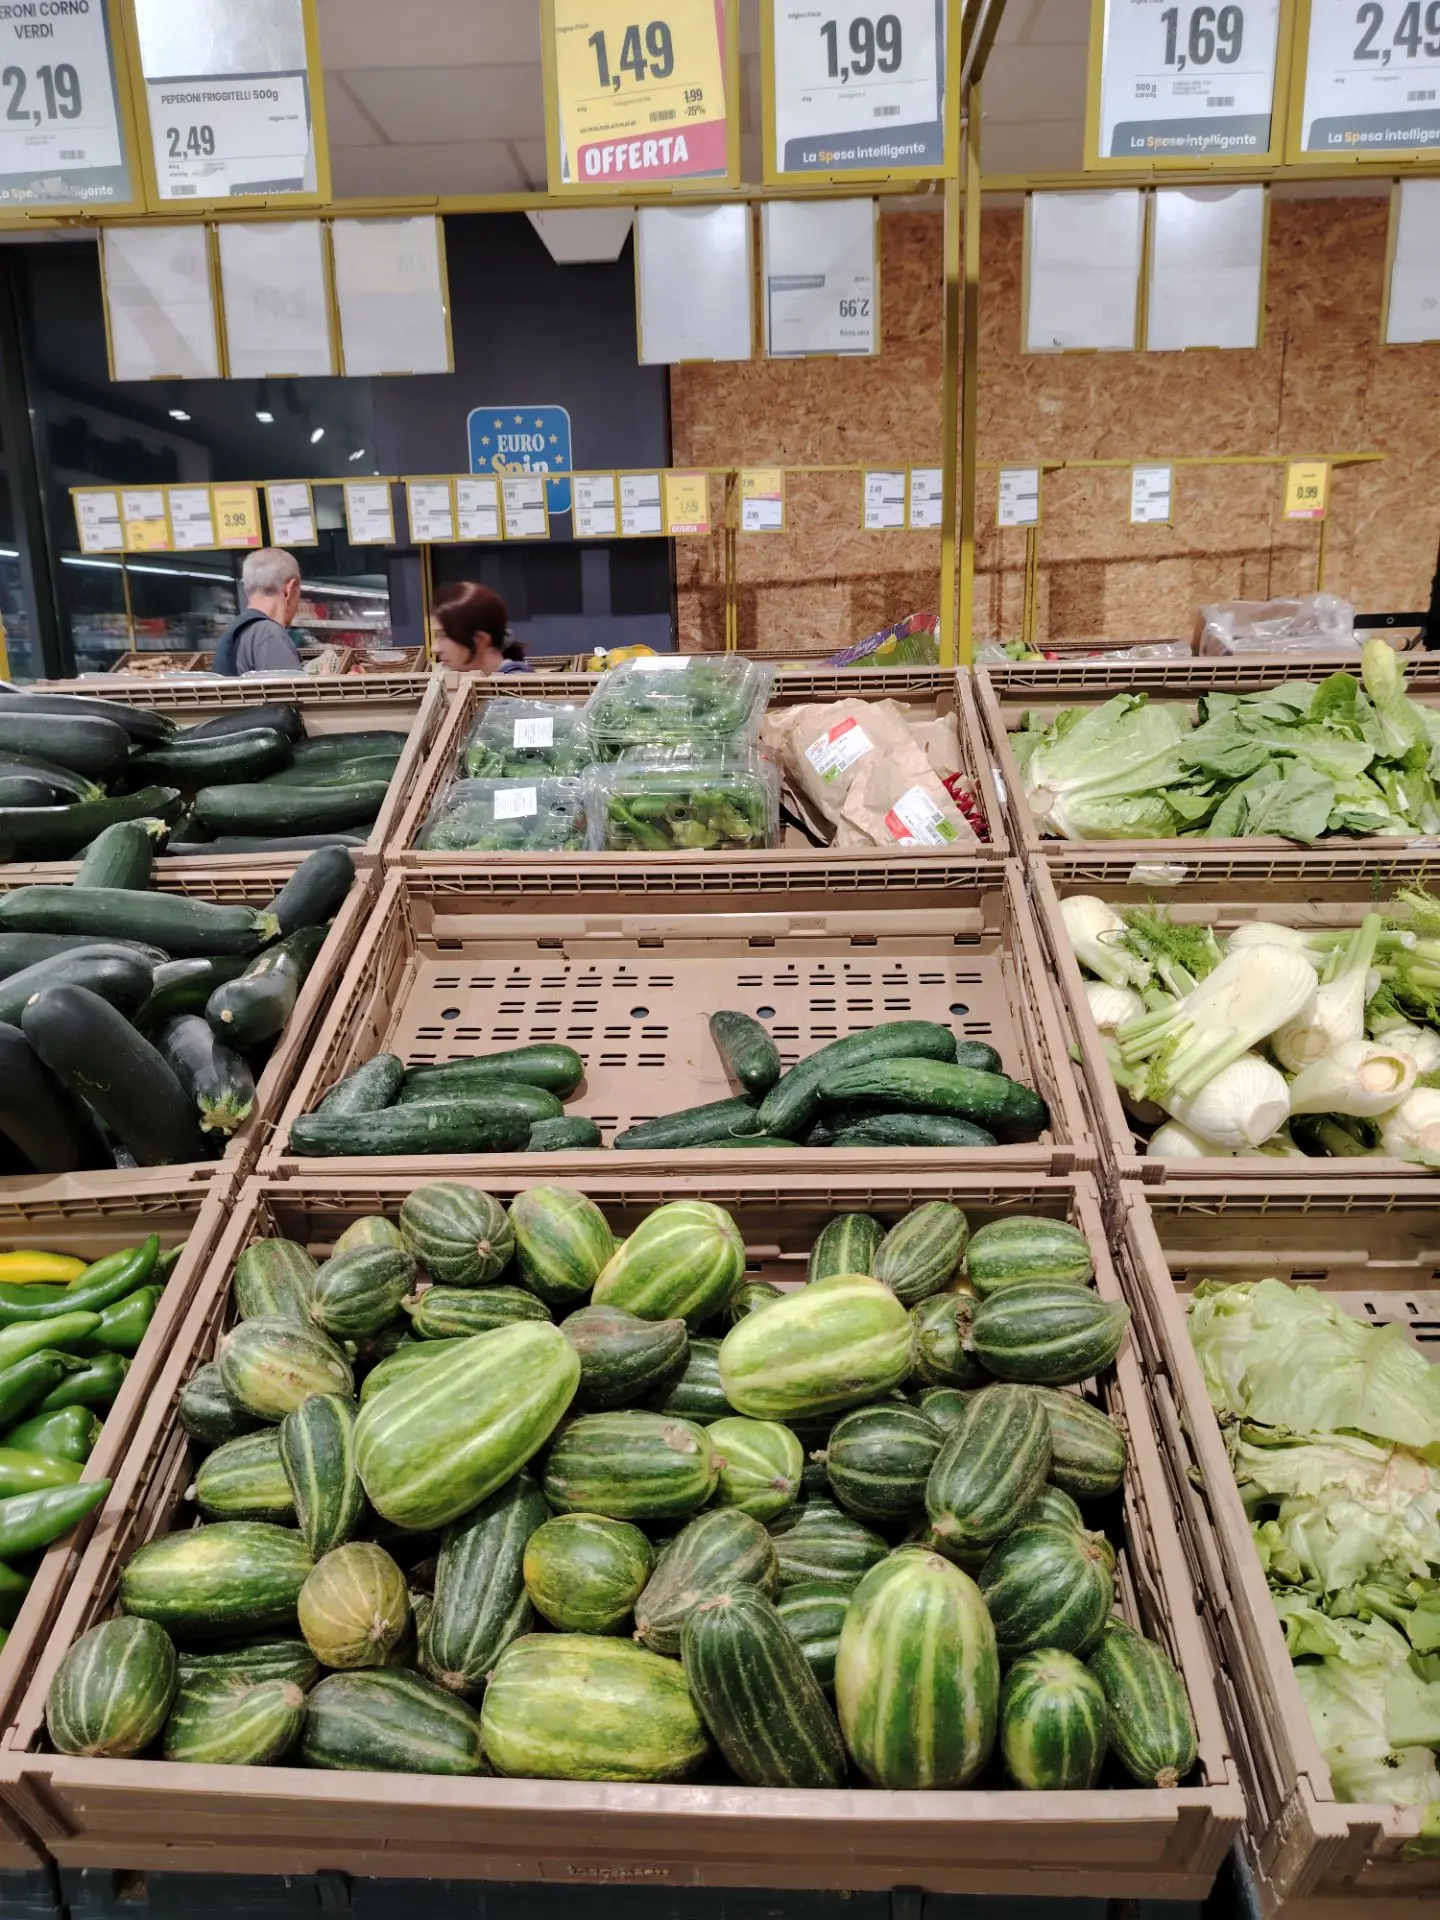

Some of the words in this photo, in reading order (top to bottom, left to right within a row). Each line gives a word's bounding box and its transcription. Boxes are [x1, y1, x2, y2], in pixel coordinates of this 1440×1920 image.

[40, 0, 89, 17] CORNO
[13, 23, 54, 39] VERDI
[1161, 5, 1244, 72] 1,69
[588, 20, 675, 92] 1,49
[820, 14, 902, 85] 1,99
[2, 63, 83, 127] 2,19
[161, 92, 201, 105] PEPERONI
[253, 89, 279, 101] 500g
[166, 125, 215, 160] 2,49
[1130, 136, 1145, 148] La
[1328, 132, 1342, 143] La
[1344, 131, 1383, 146] Spesa
[584, 134, 688, 176] OFFERTA
[802, 152, 817, 164] La
[819, 148, 855, 165] Spesa
[857, 142, 926, 160] intelligente
[839, 297, 870, 318] 2,99
[496, 433, 545, 452] EURO
